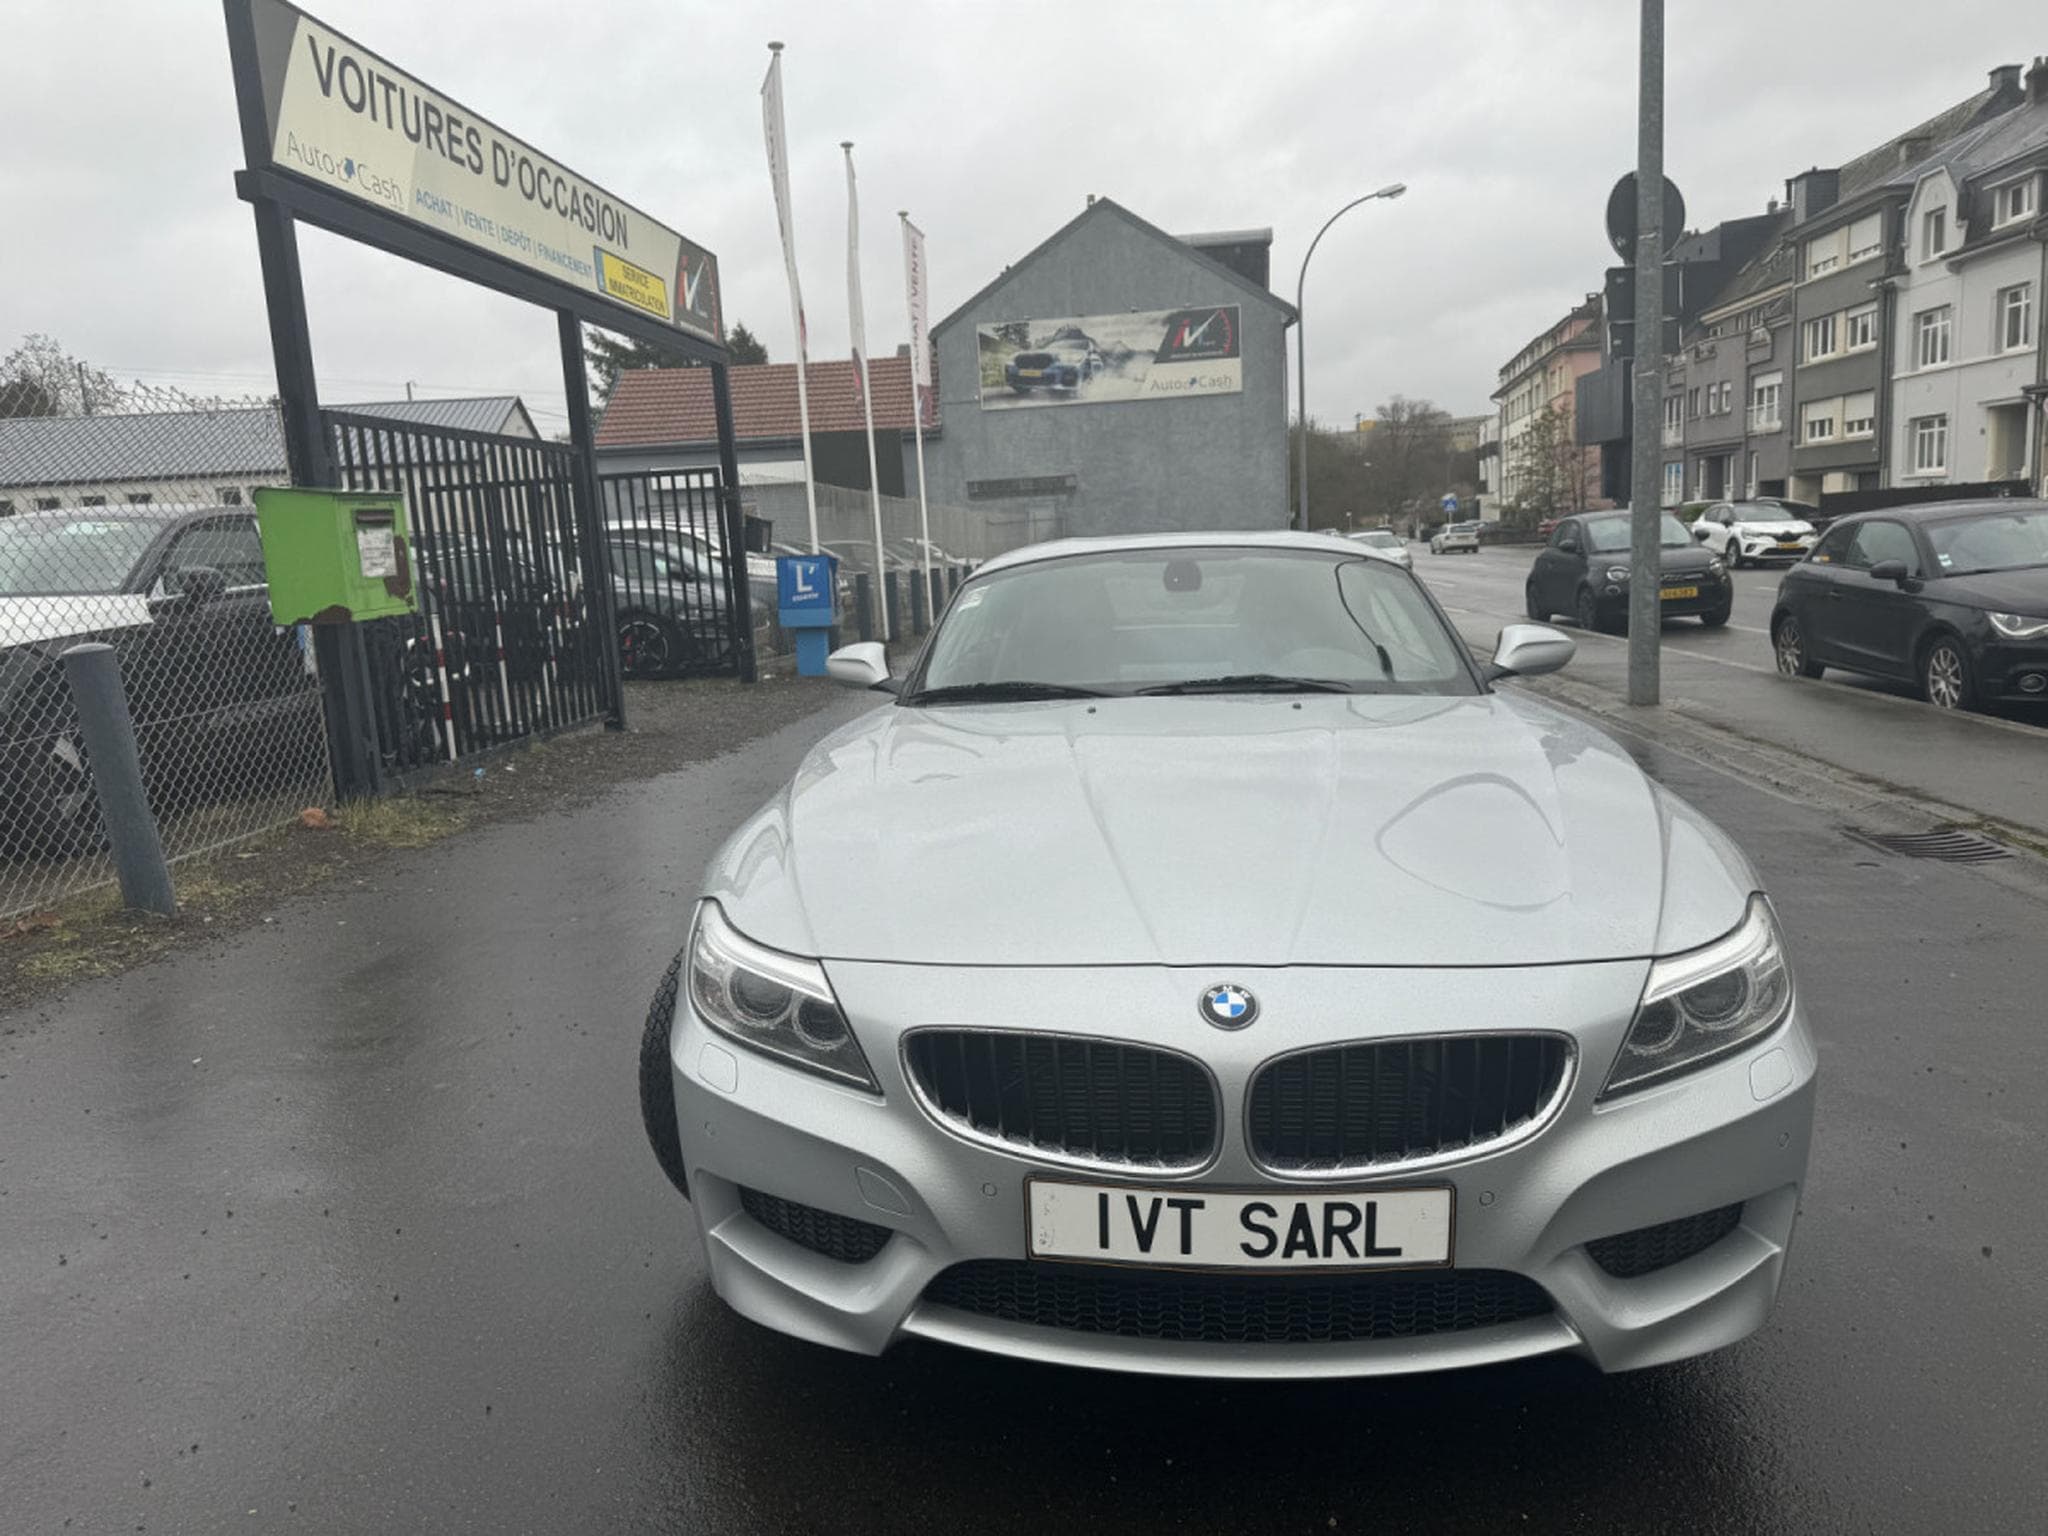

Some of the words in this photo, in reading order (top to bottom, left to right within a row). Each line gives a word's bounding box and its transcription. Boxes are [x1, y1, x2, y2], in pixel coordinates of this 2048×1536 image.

[287, 131, 335, 175] Auto
[357, 163, 404, 206] Cash
[307, 34, 484, 175] VOITURES
[492, 139, 628, 250] D'OCCASION
[415, 188, 454, 218] ACHAT
[462, 211, 496, 237] VENTE
[1208, 985, 1251, 998] BMW
[1098, 1192, 1206, 1255] IVT
[1239, 1200, 1402, 1259] SARL
